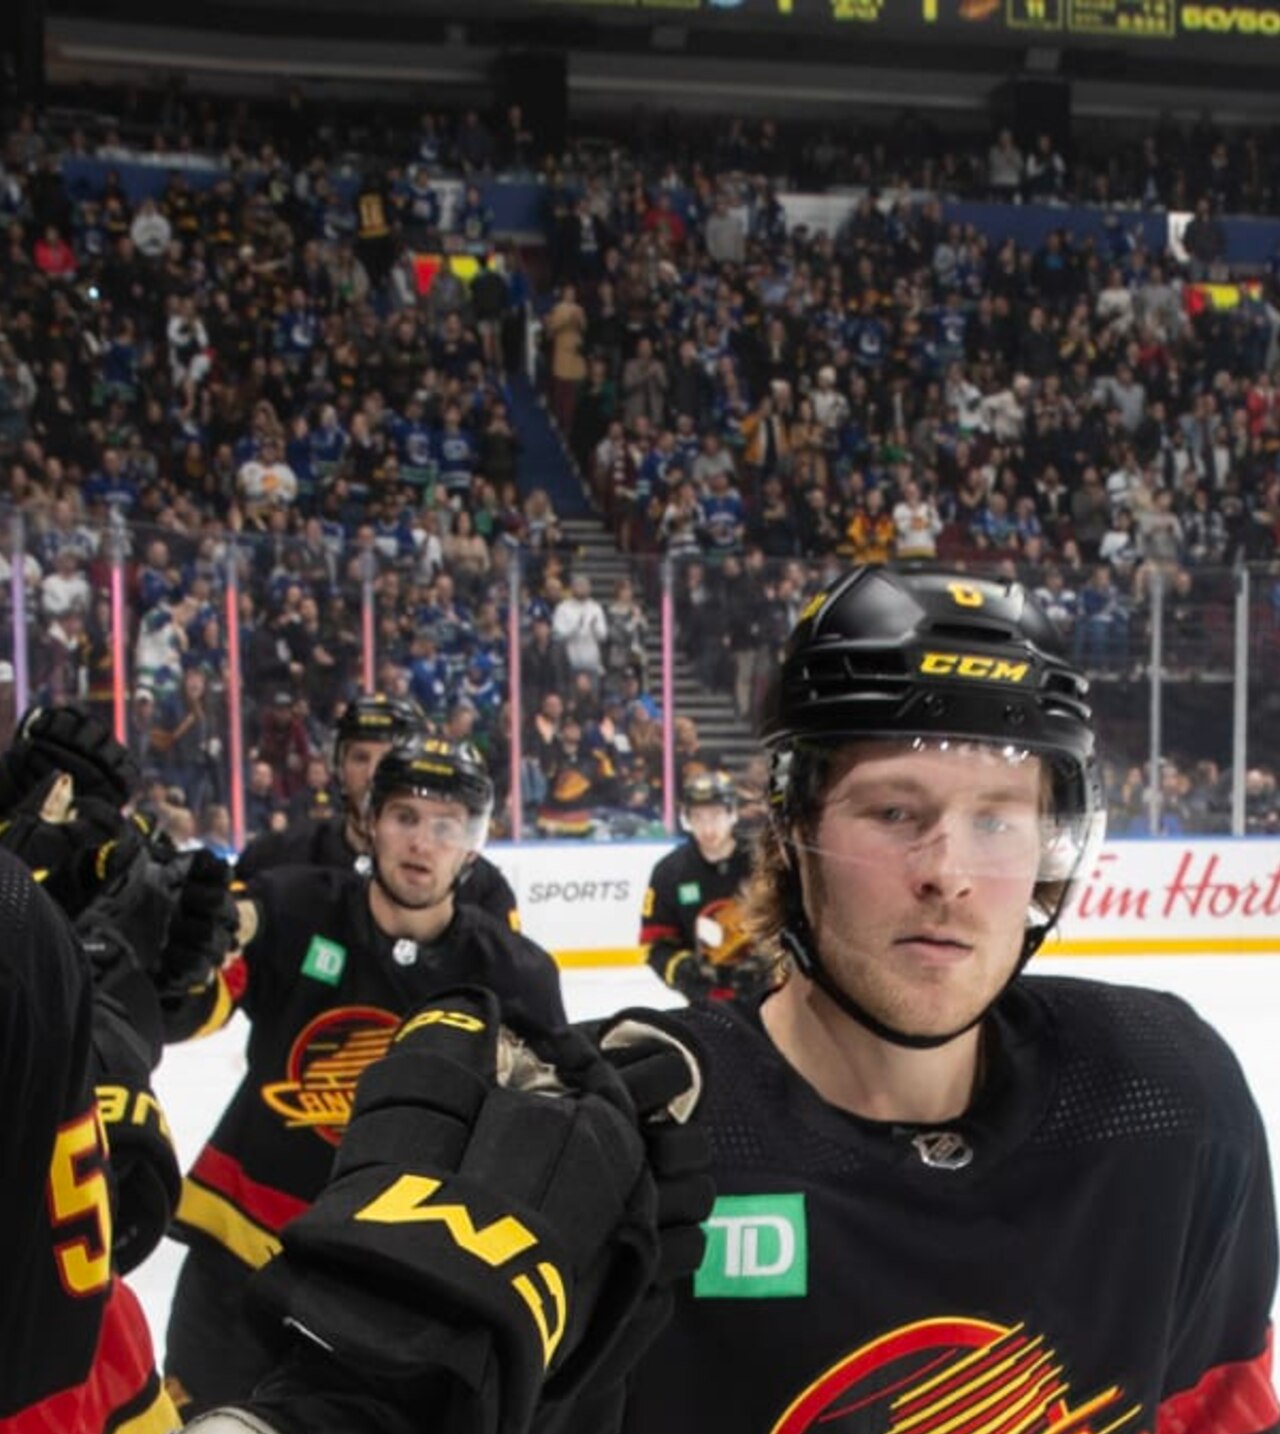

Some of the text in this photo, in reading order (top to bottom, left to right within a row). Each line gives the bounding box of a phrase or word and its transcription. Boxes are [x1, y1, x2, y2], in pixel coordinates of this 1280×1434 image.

[920, 652, 1029, 682] CCM
[527, 880, 631, 903] SPORTS
[1077, 854, 1149, 920] im
[704, 1213, 796, 1278] TD
